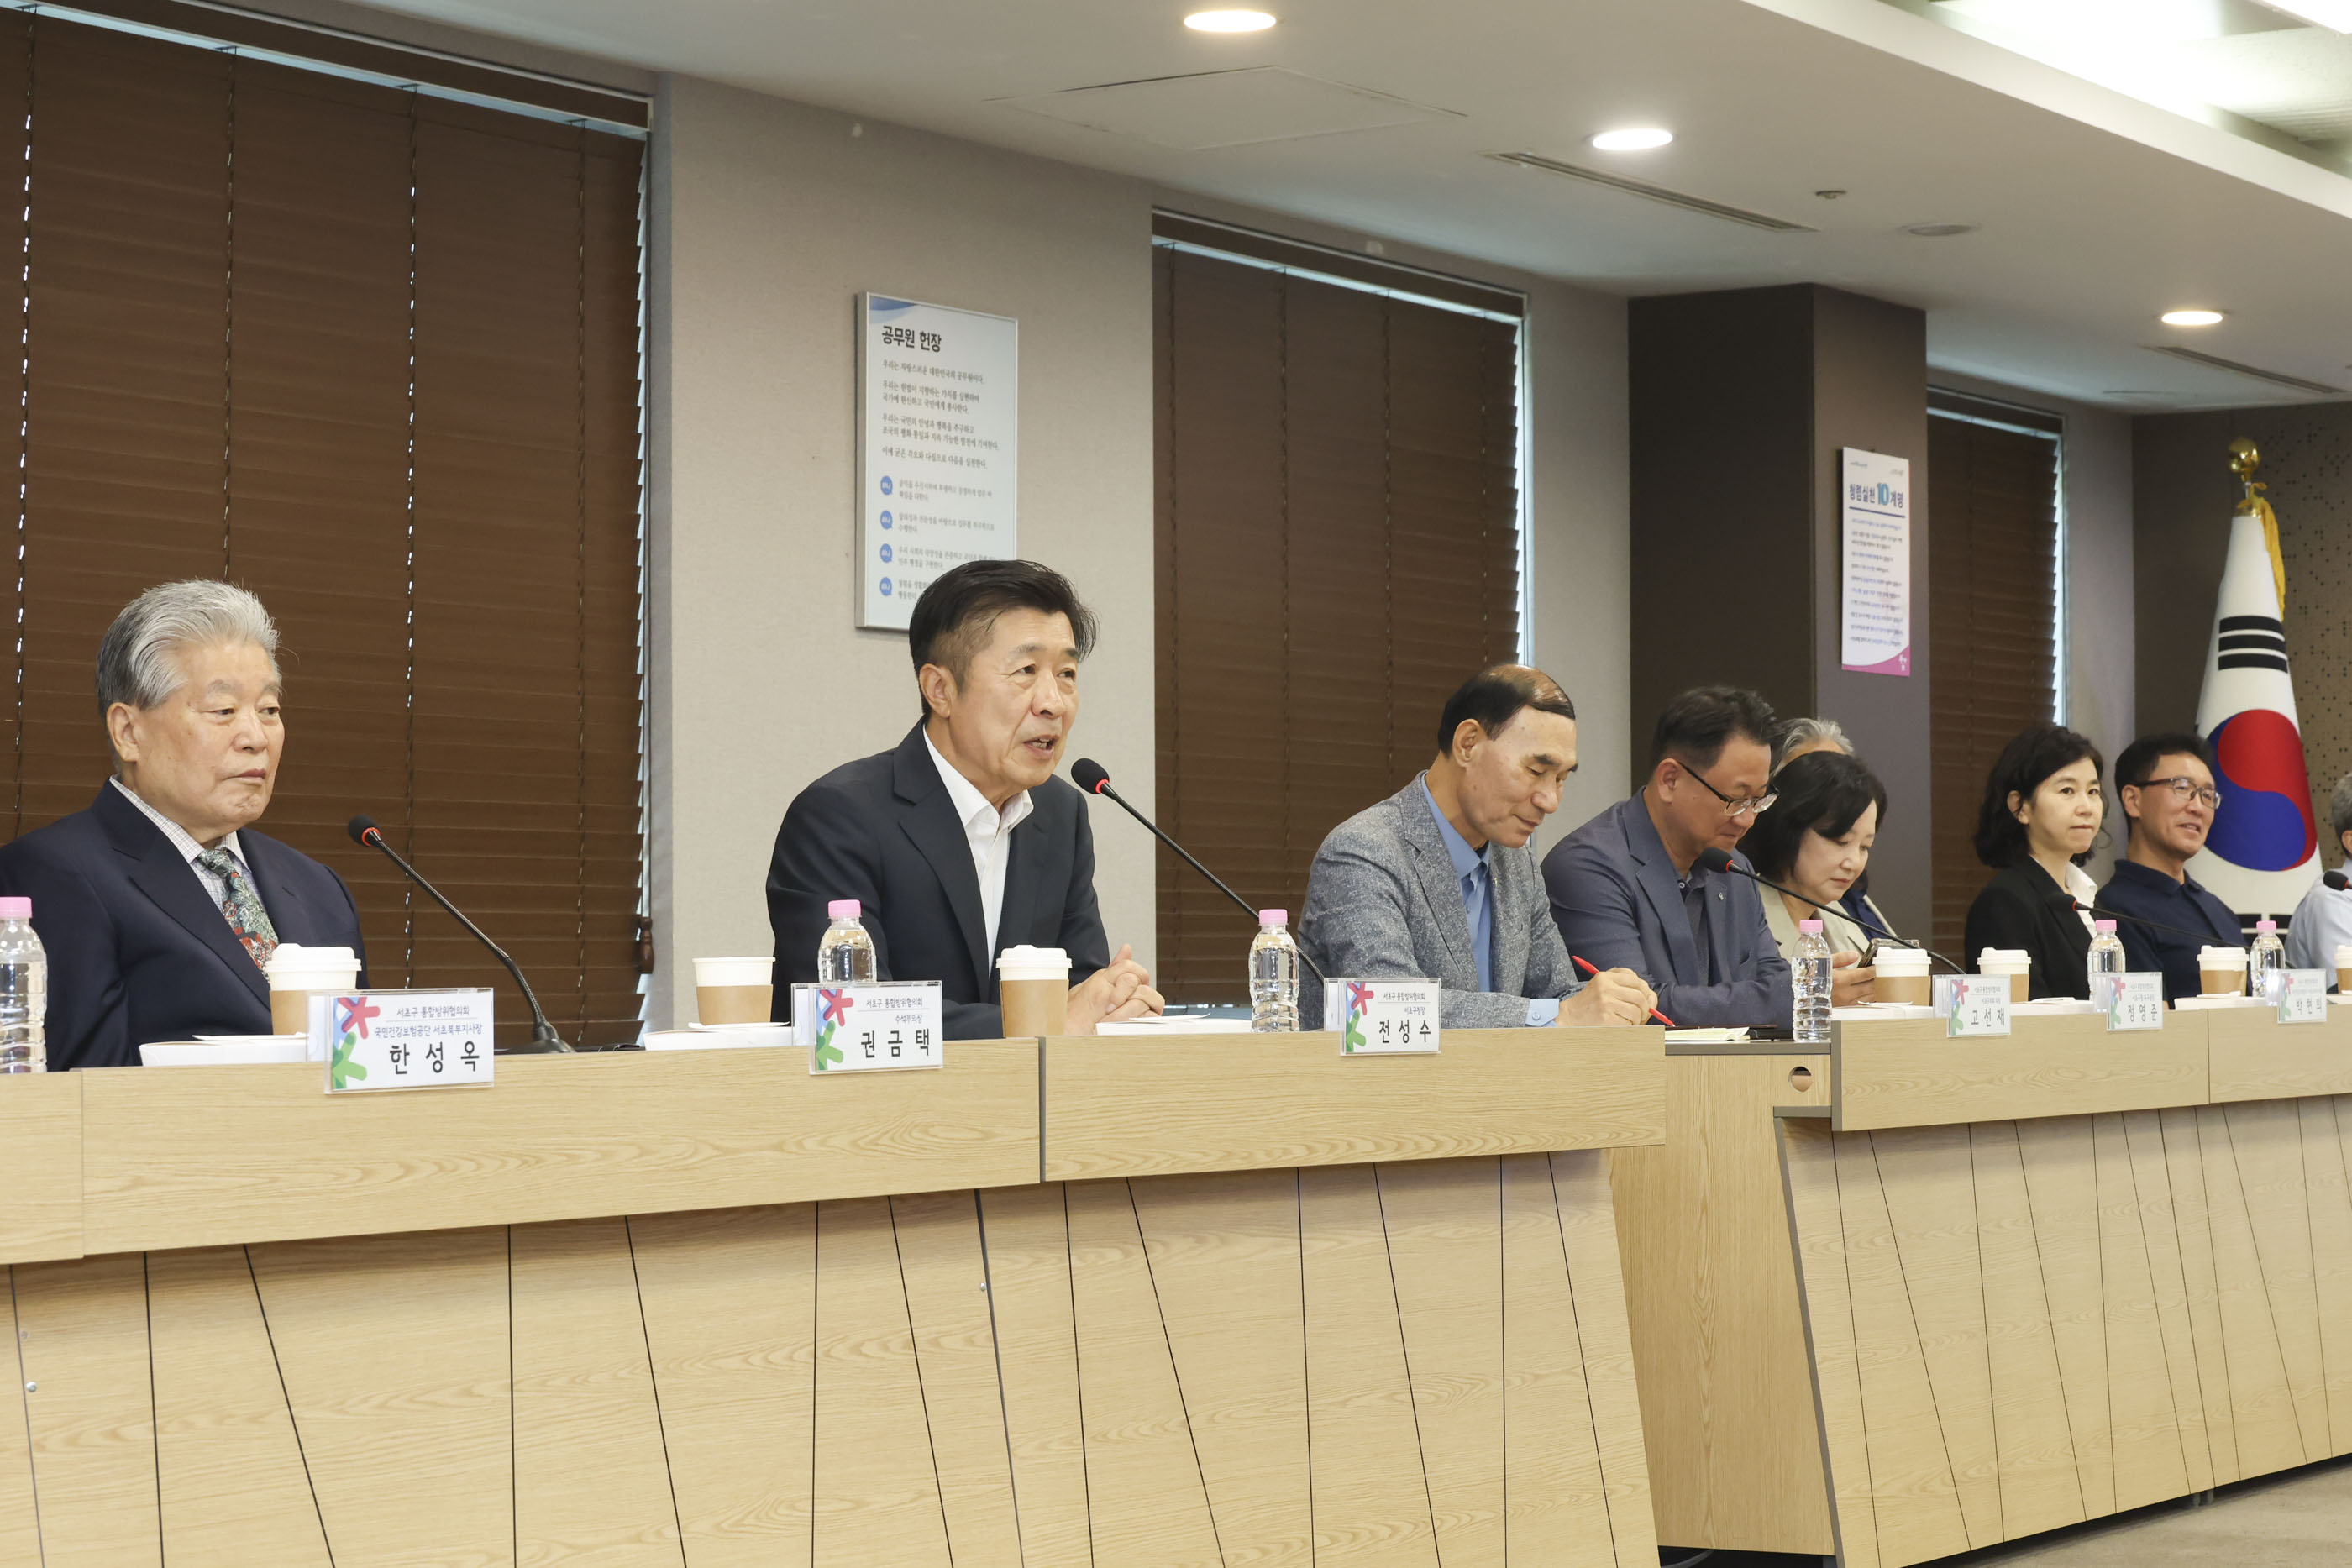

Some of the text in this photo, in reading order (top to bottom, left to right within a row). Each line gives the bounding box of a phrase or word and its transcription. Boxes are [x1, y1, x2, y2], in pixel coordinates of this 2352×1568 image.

[881, 325, 942, 353] 공무원 헌장
[866, 997, 923, 1009] 서초구 통합방위협의회
[396, 1005, 470, 1019] 서초구 통합방위협의회
[895, 1014, 922, 1024] 수석부의장
[374, 1023, 483, 1039] 국민건강보험공단 서초북부지사장
